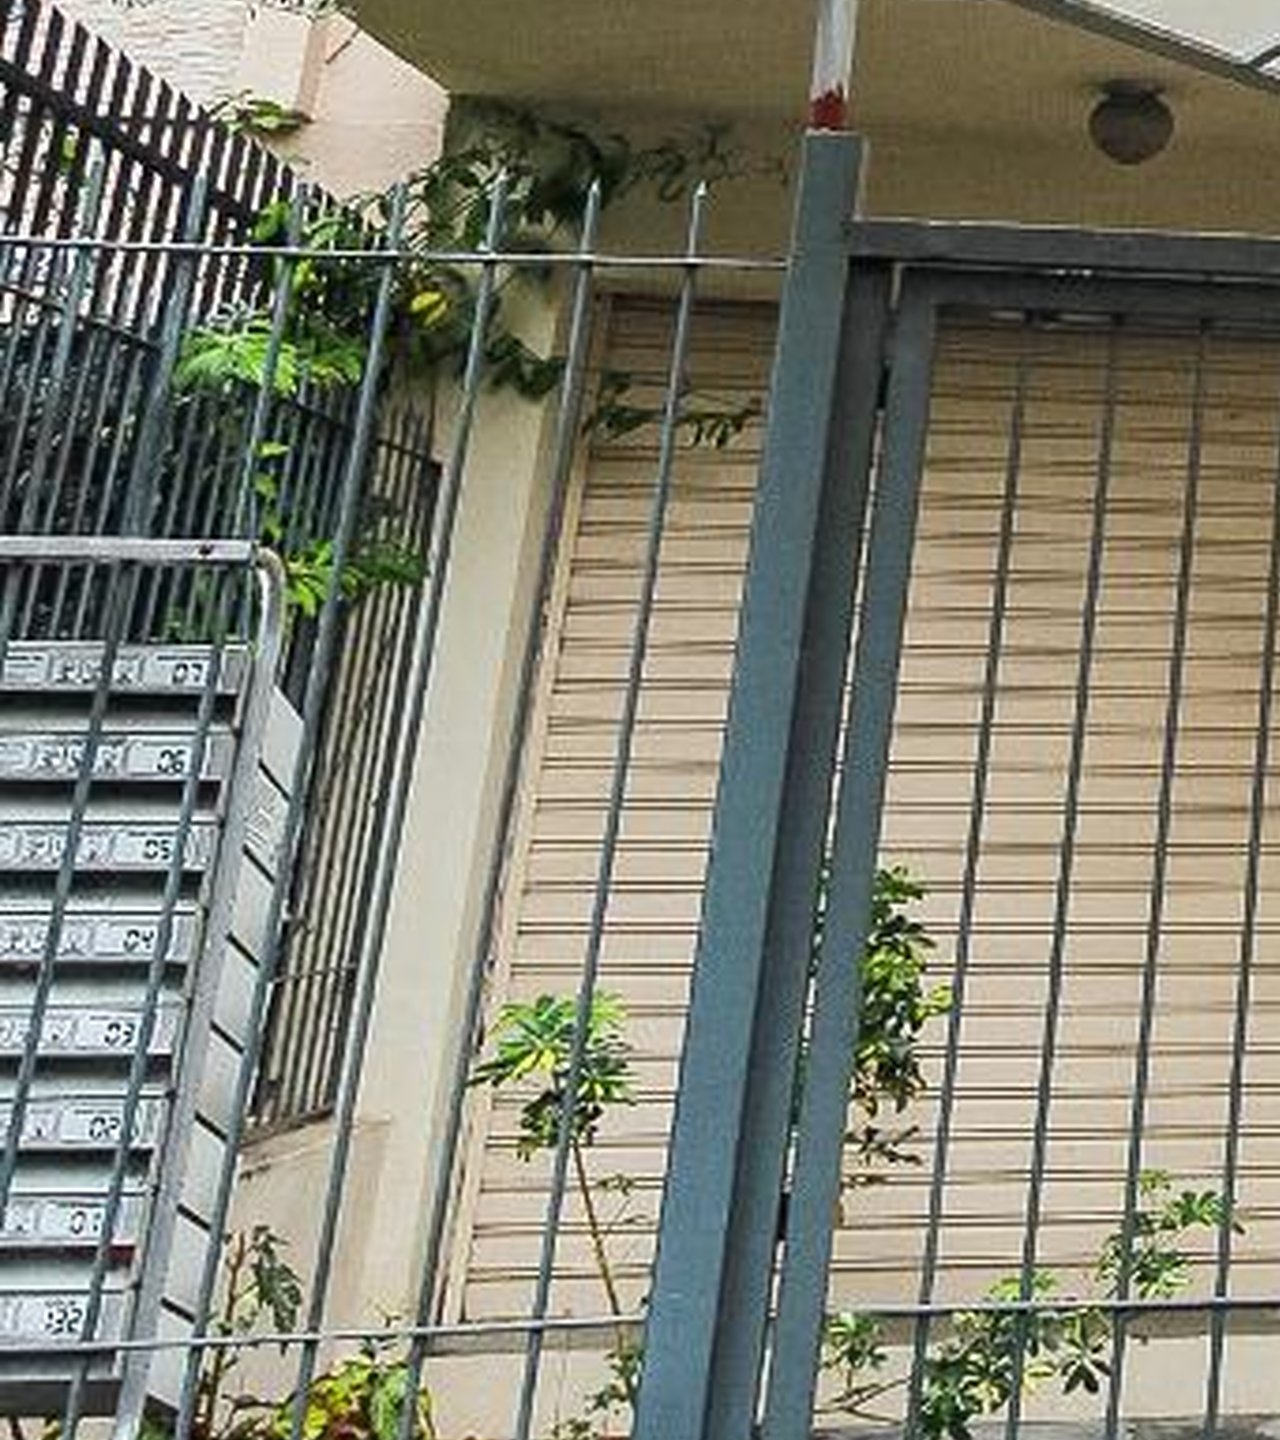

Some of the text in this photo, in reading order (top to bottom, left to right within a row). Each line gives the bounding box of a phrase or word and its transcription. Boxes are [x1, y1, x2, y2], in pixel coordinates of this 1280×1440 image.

[156, 749, 188, 774] 06
[142, 838, 172, 861] 05
[104, 1021, 135, 1046] 03
